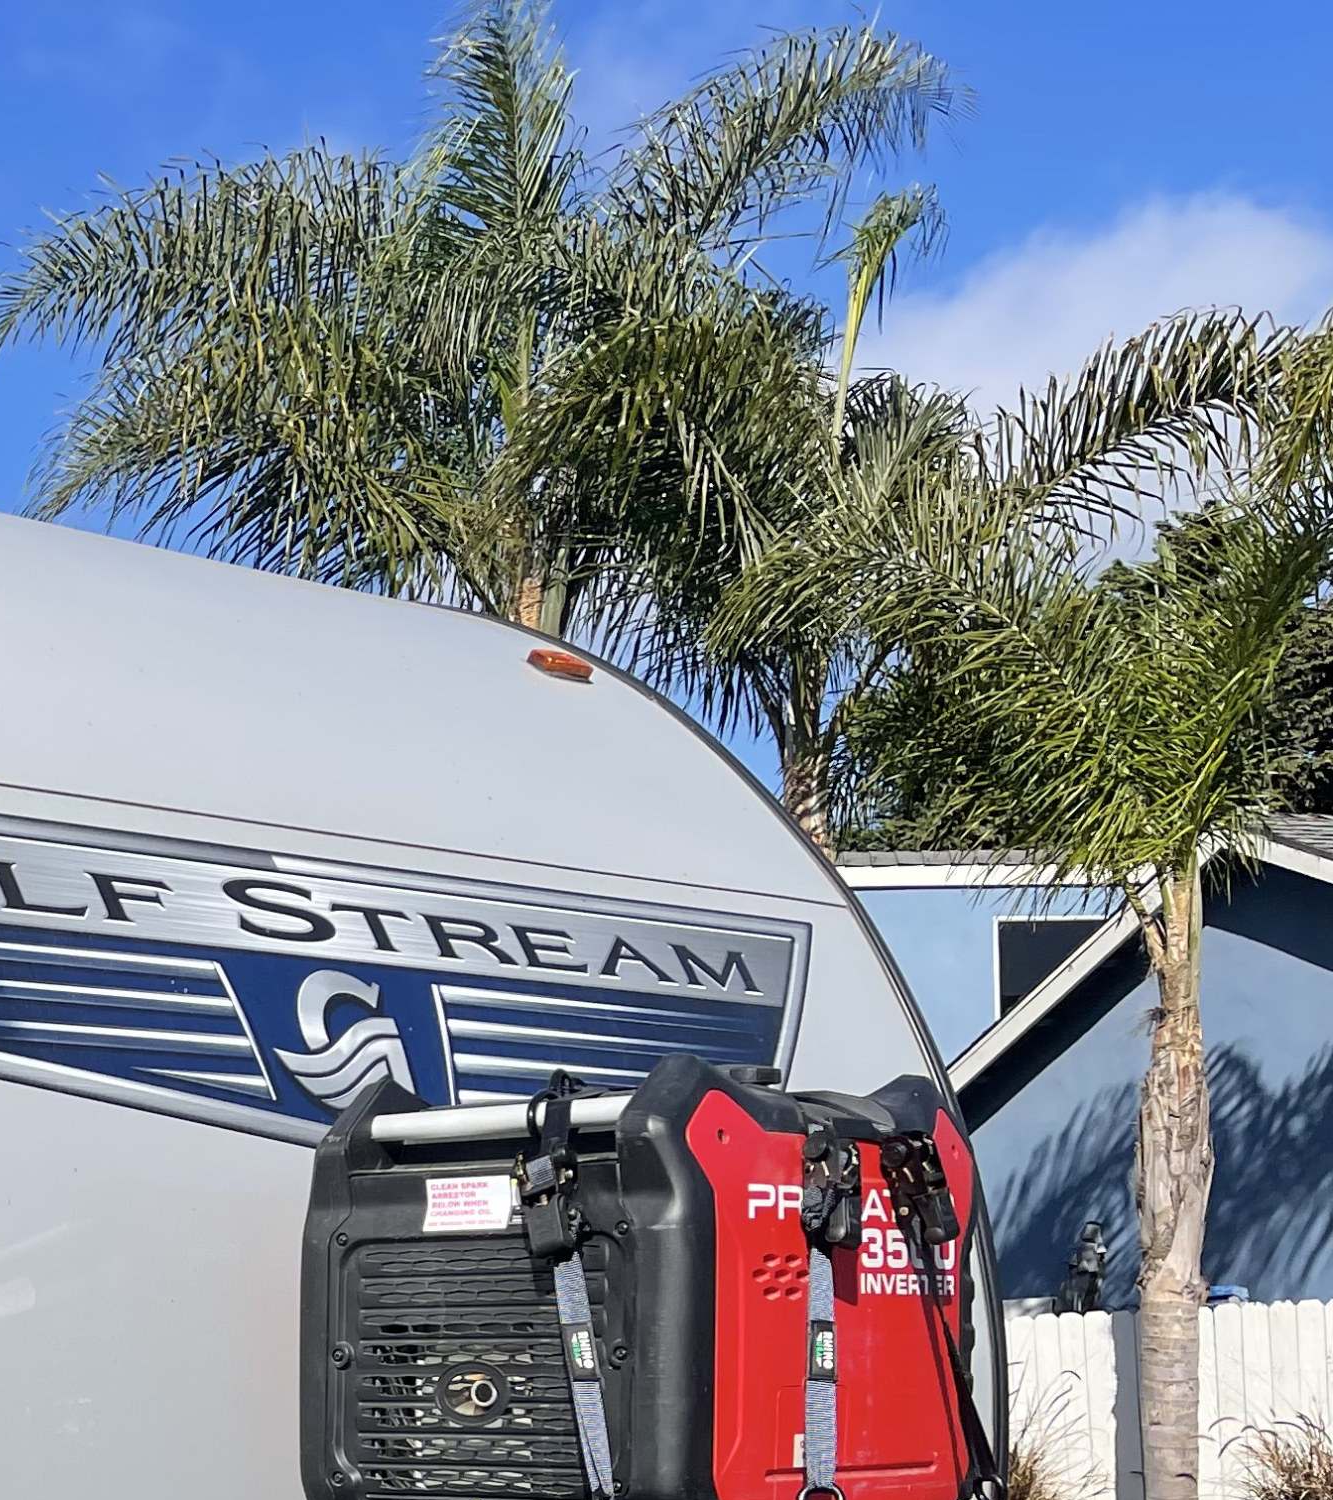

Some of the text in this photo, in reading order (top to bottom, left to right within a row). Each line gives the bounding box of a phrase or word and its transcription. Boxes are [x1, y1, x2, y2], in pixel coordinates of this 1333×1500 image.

[222, 878, 765, 997] STREAM
[430, 1183, 458, 1191] CLEAN
[431, 1191, 476, 1199] ARRESTOR
[431, 1201, 460, 1209] BELOW
[860, 1273, 955, 1296] INVERTER
[577, 1331, 594, 1369] RHINO
[823, 1331, 833, 1369] RHINO
